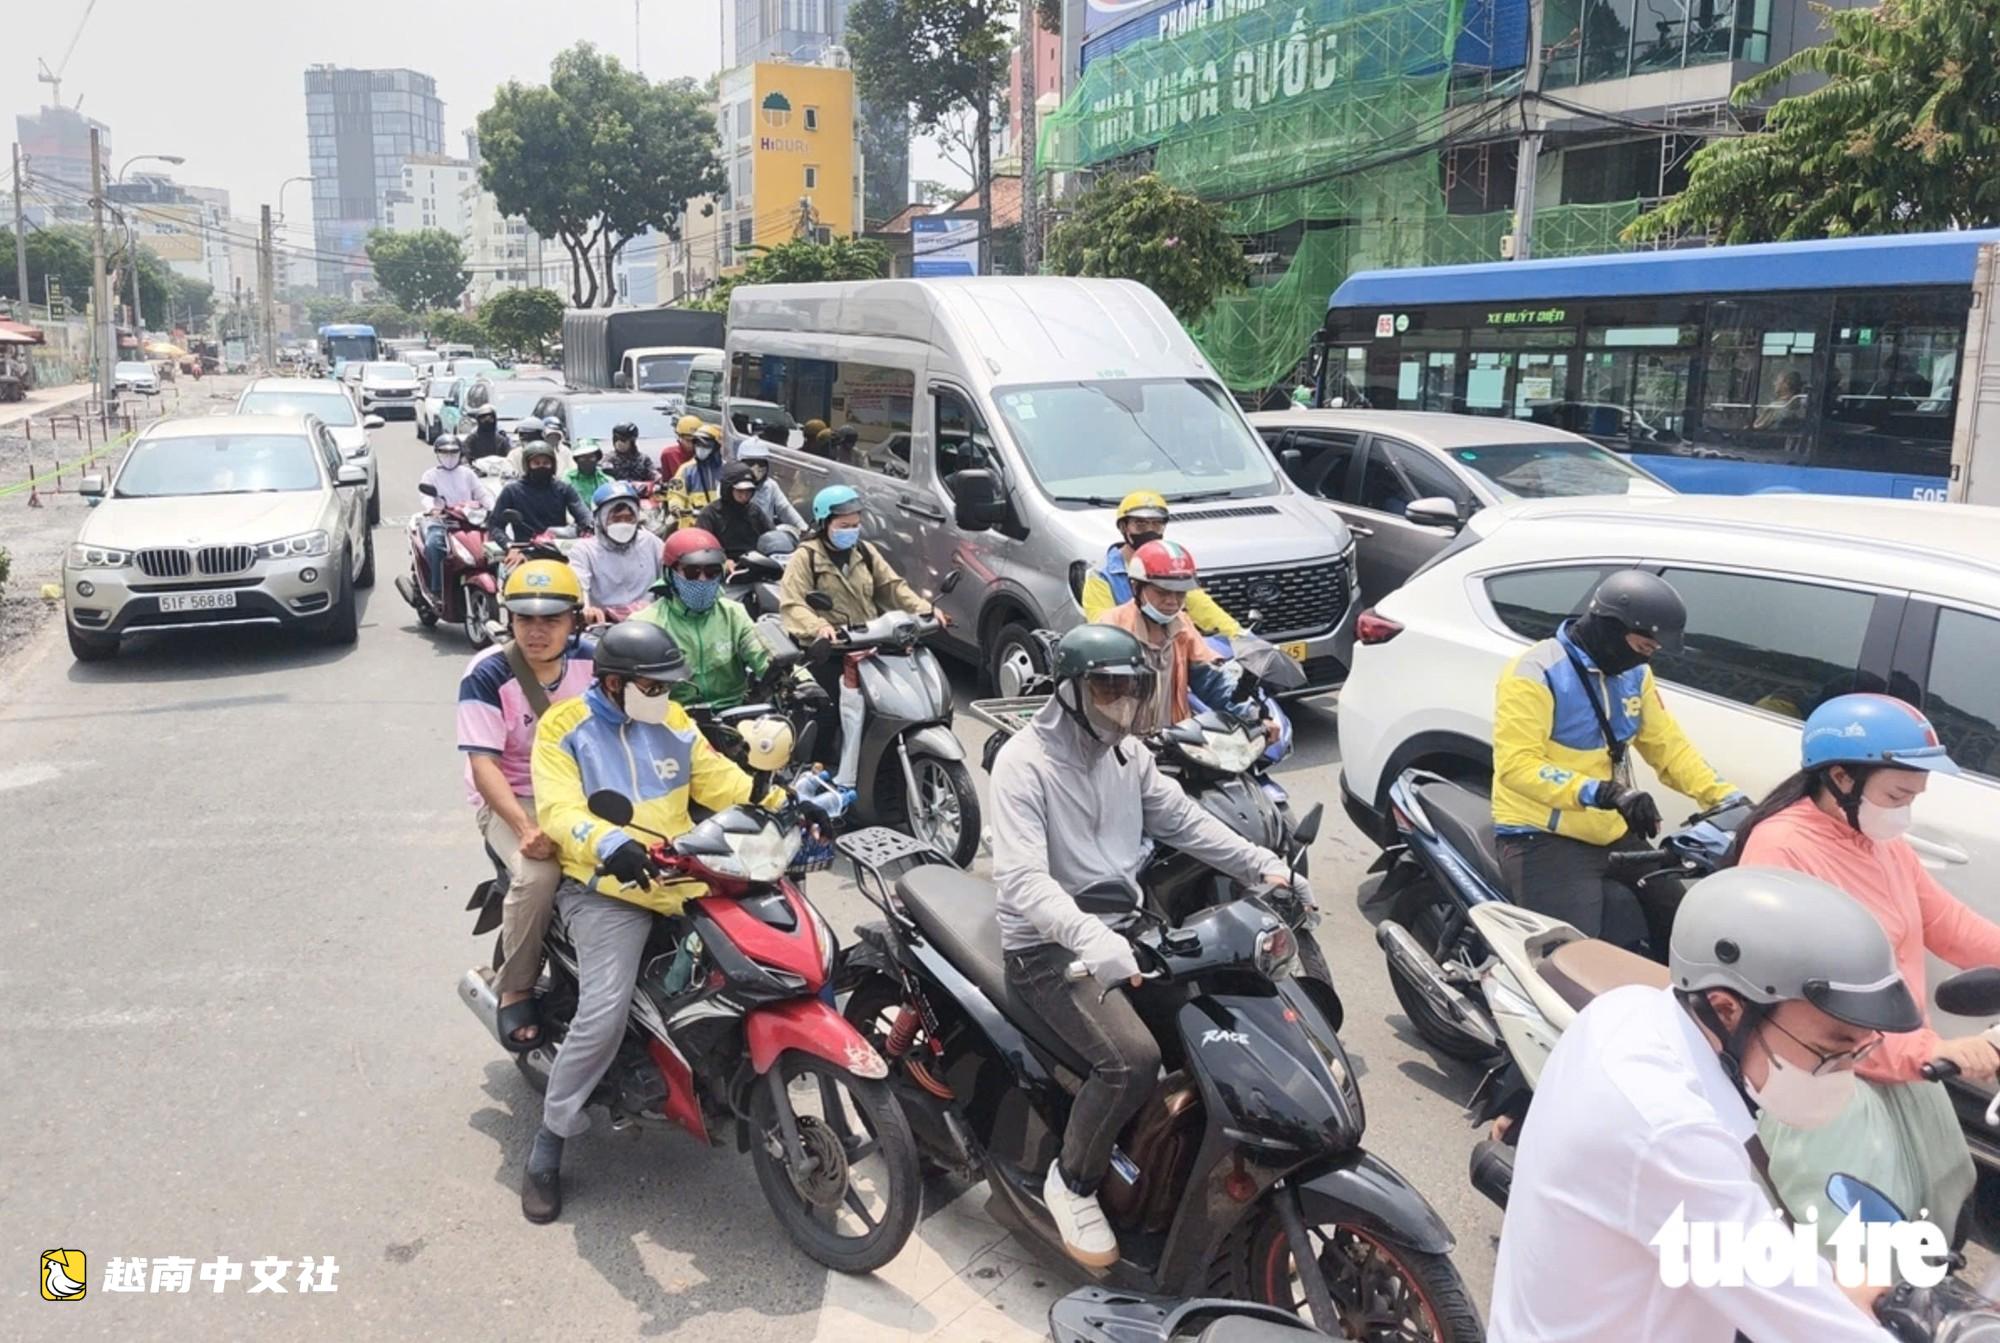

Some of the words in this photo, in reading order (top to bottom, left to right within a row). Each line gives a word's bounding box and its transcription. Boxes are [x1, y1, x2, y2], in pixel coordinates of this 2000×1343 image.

[1143, 60, 1219, 134] KHOA
[1231, 7, 1338, 111] QUỐC
[161, 596, 186, 611] 51F
[1200, 1029, 1250, 1049] RACE
